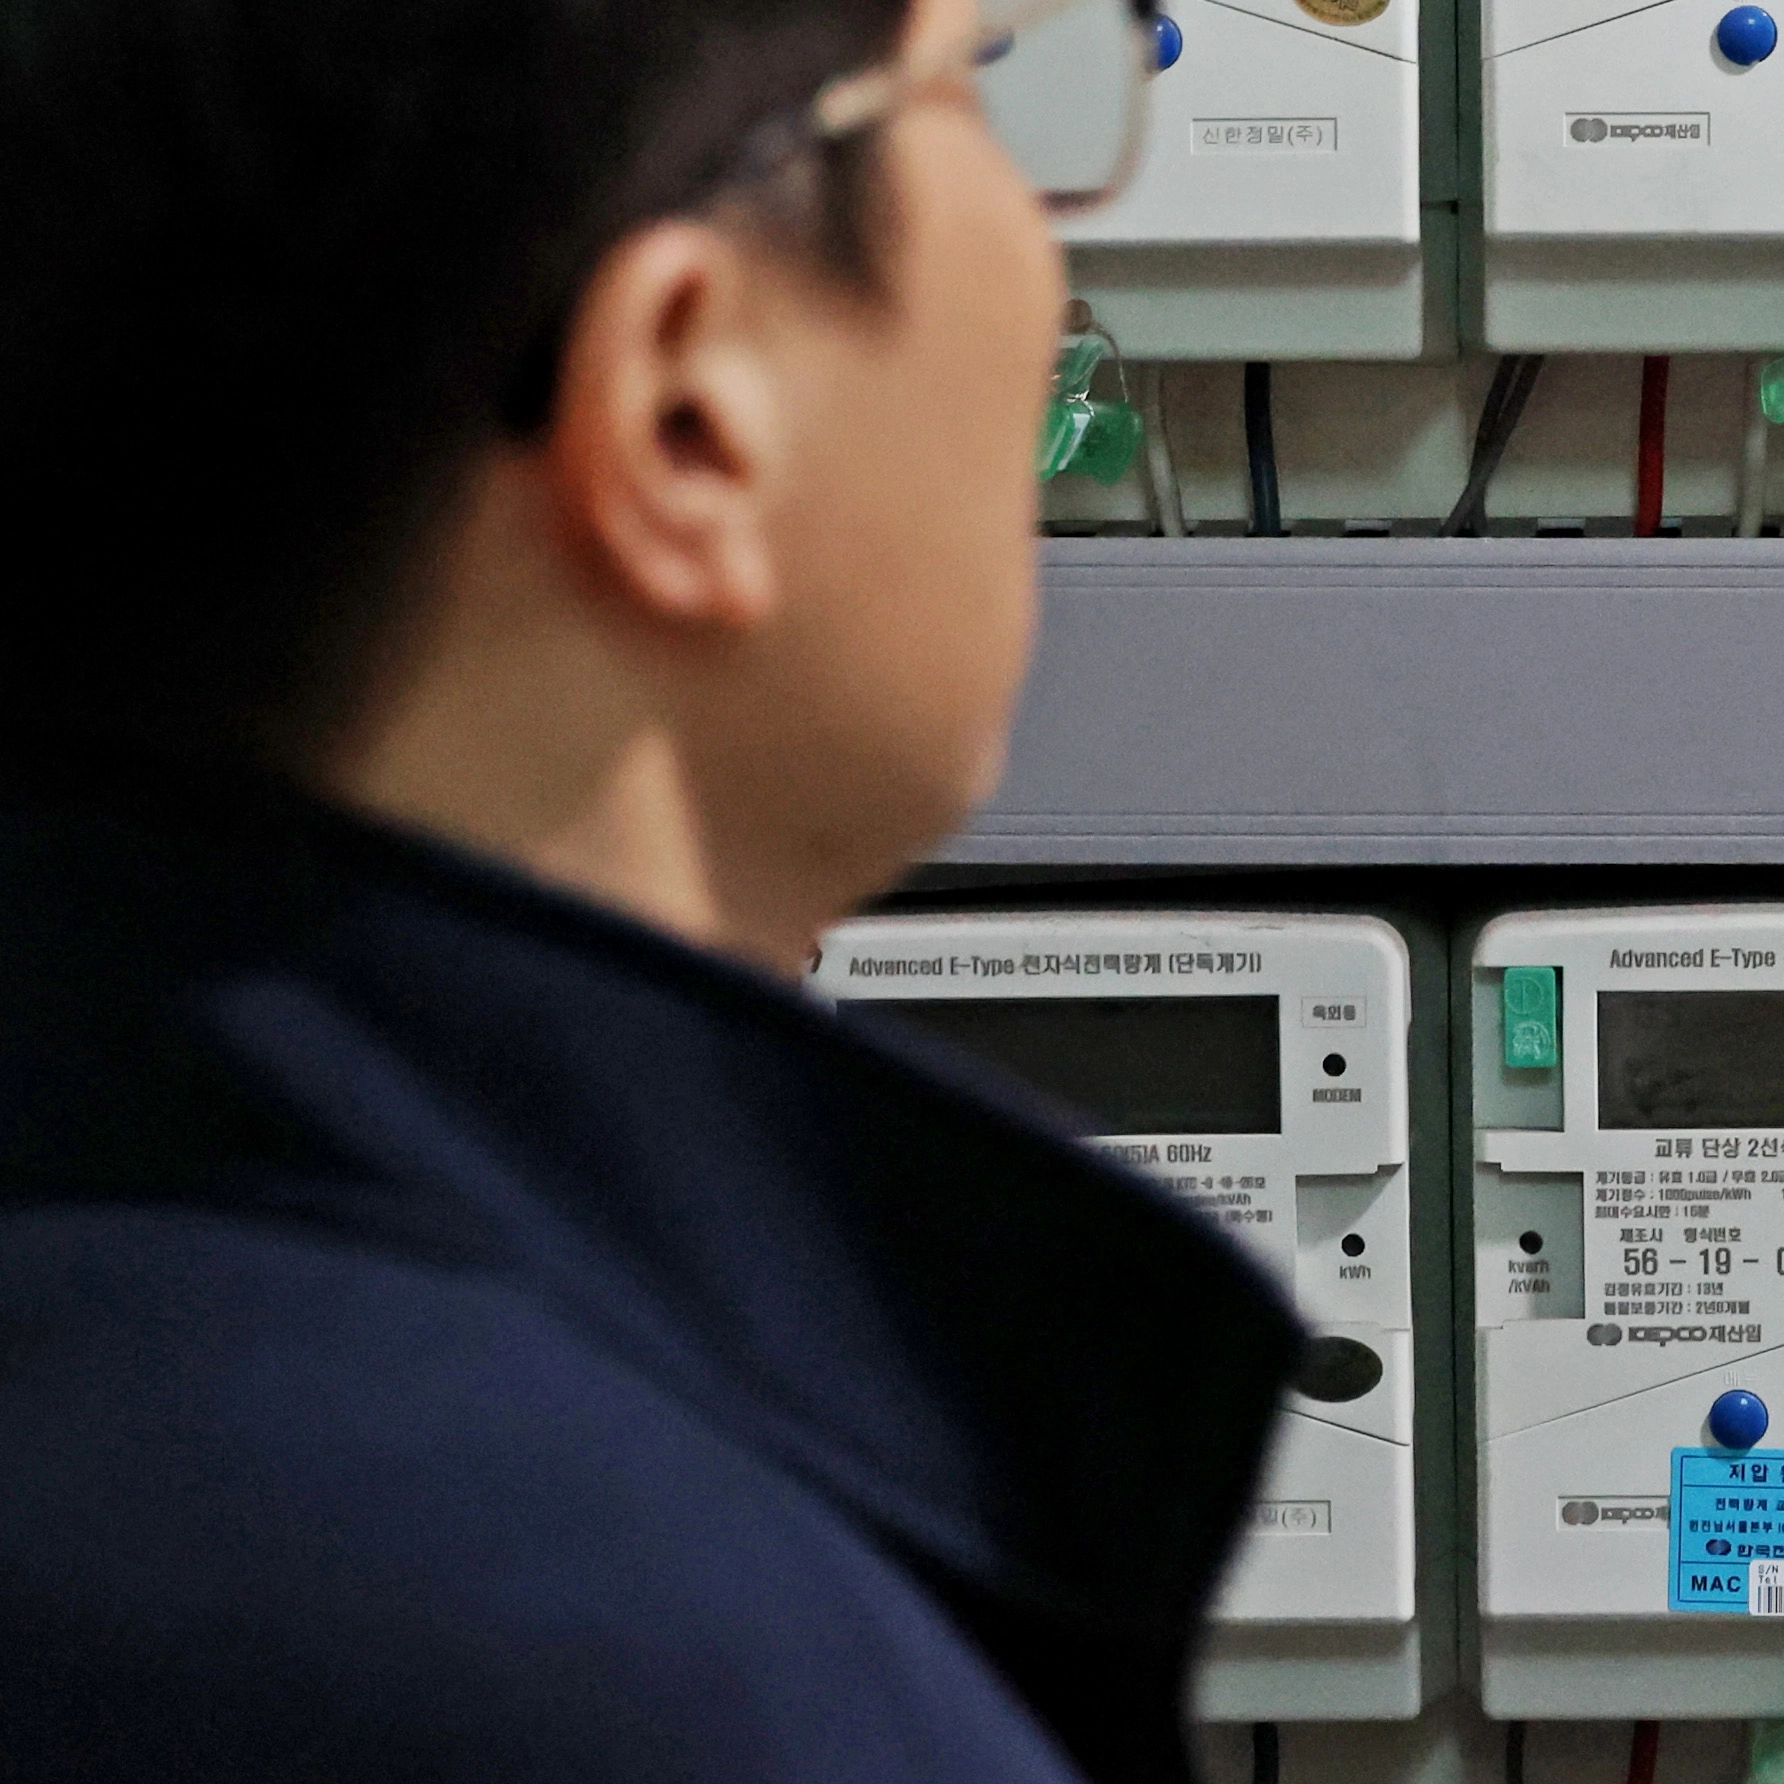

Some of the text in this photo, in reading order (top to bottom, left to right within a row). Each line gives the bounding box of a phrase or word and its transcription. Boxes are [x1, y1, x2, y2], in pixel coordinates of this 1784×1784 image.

[849, 955, 1014, 977] Advanced E-Type
[1610, 948, 1775, 969] Advanced E-Type
[1167, 1144, 1212, 1163] 60Hz
[1624, 1248, 1658, 1275] 56
[1699, 1247, 1731, 1275] 19
[1691, 1575, 1741, 1592] MAC
